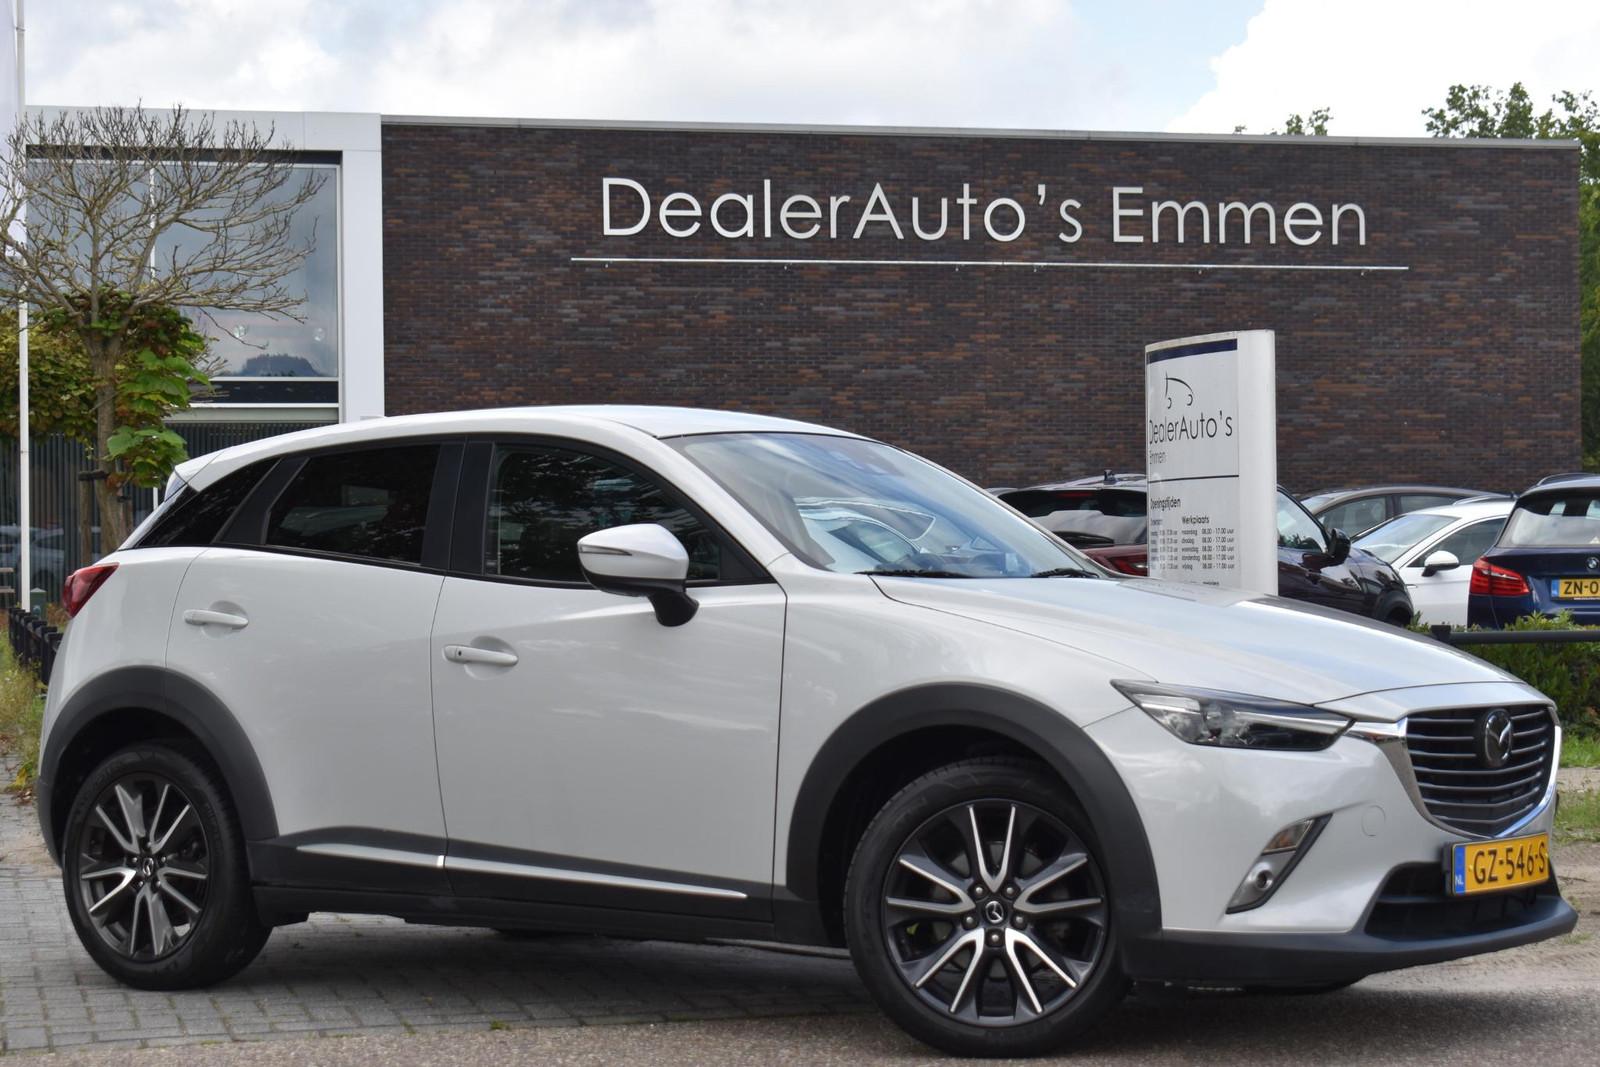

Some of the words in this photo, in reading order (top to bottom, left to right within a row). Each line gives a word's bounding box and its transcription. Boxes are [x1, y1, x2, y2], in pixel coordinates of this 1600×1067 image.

[602, 177, 1082, 243] DealerAuto's
[1112, 186, 1366, 246] Emmen
[1148, 411, 1233, 444] DealerAuto's
[1182, 515, 1210, 525] Werkplaats
[1473, 841, 1546, 884] GZ-546-S
